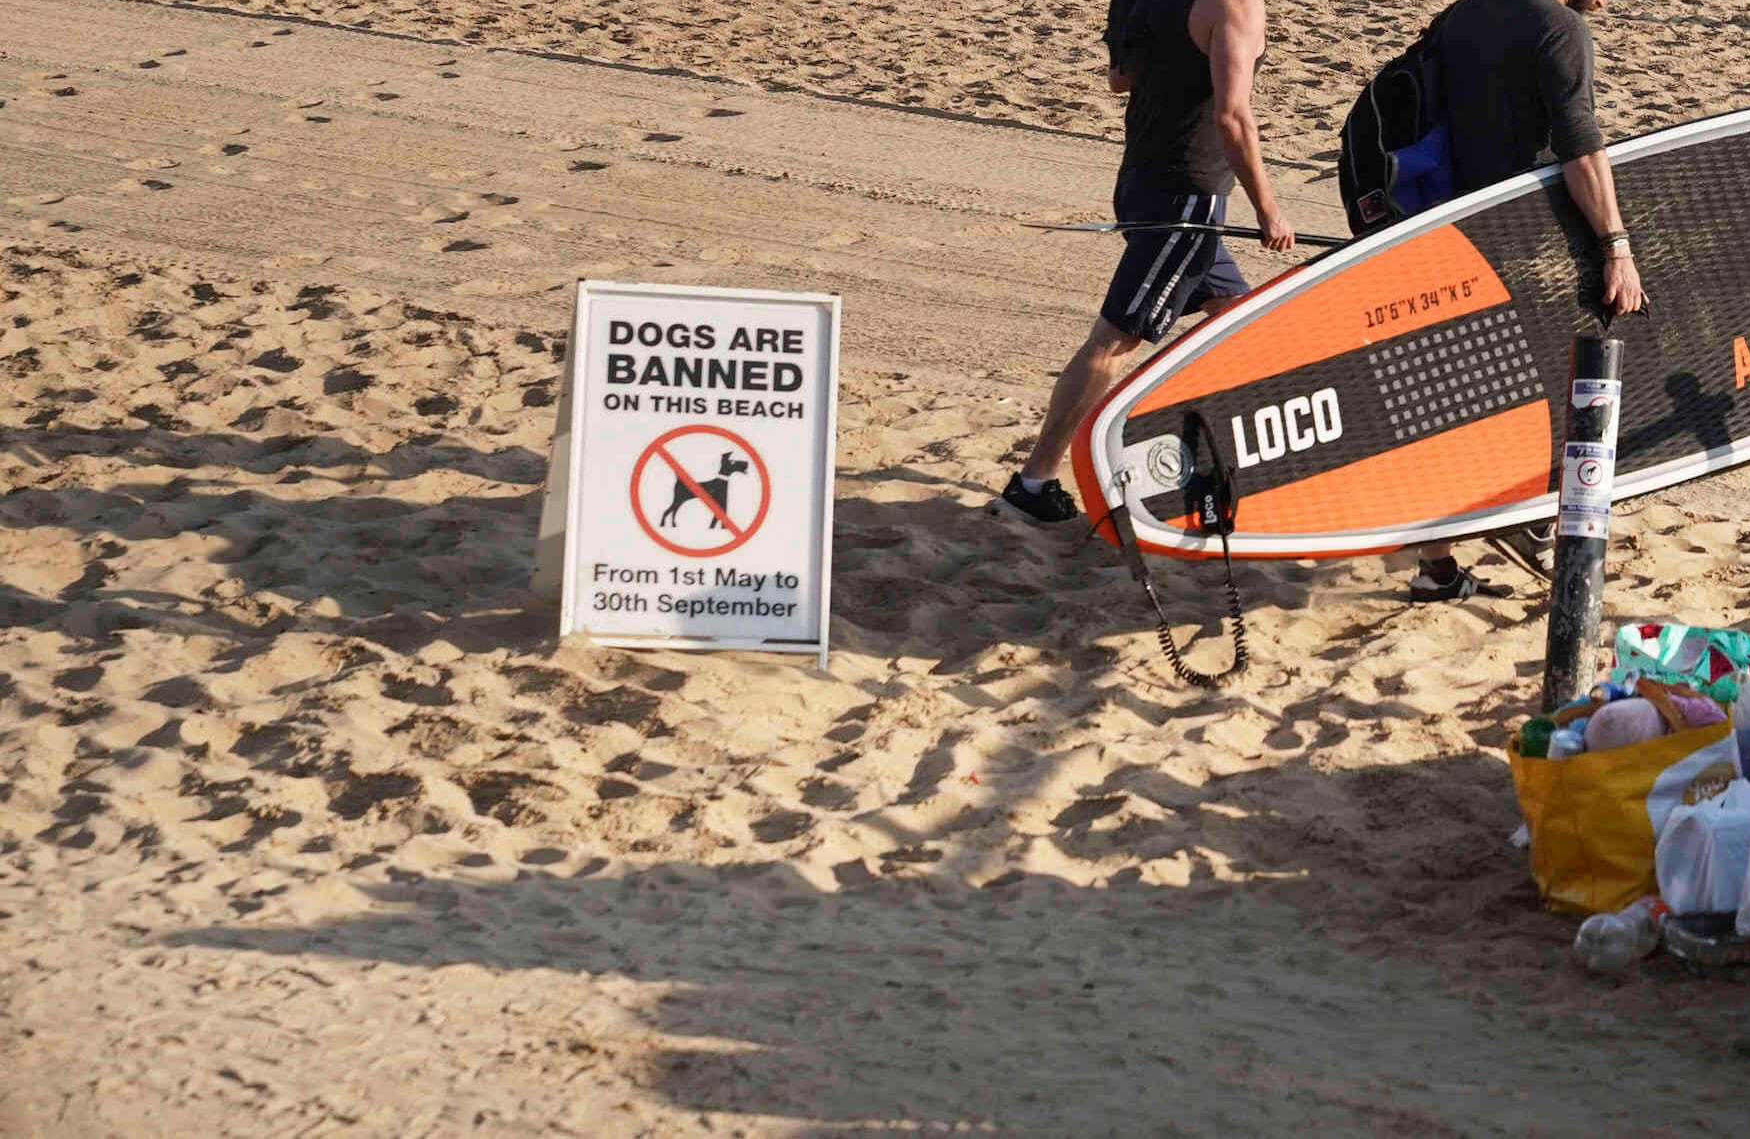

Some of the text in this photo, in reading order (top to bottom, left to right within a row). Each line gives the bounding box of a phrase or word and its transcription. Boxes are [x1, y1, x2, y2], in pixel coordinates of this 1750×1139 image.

[609, 320, 804, 353] DOGS ARE
[606, 354, 803, 393] BANNED
[604, 394, 803, 419] ON THIS BEACH
[1231, 387, 1343, 470] LOCO
[593, 563, 800, 592] From 1st May to
[593, 592, 798, 619] 30th September
